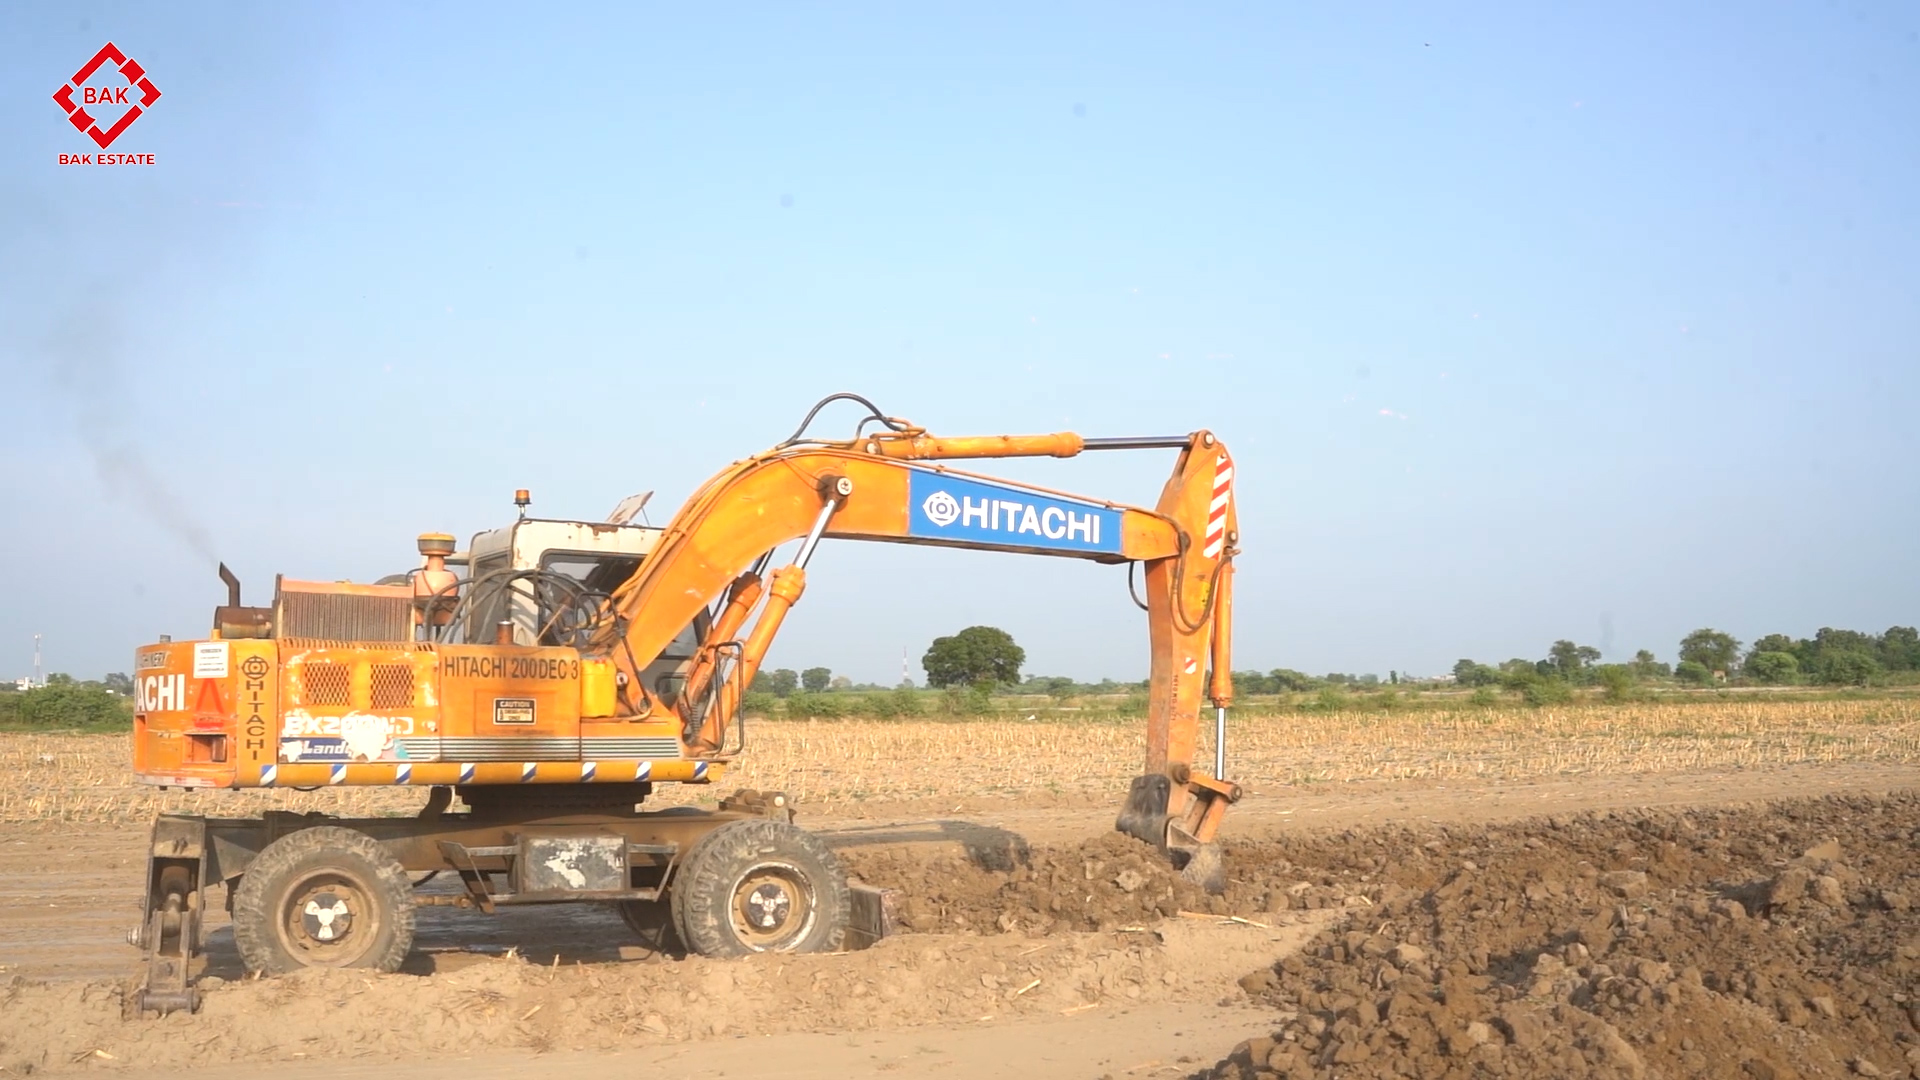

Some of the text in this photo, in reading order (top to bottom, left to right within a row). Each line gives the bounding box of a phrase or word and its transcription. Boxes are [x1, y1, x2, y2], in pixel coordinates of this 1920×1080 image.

[962, 496, 1100, 544] HITACHI
[444, 656, 507, 678] HITACHI
[571, 660, 579, 680] 3
[134, 674, 185, 712] ACHI
[246, 680, 265, 761] HITACHI
